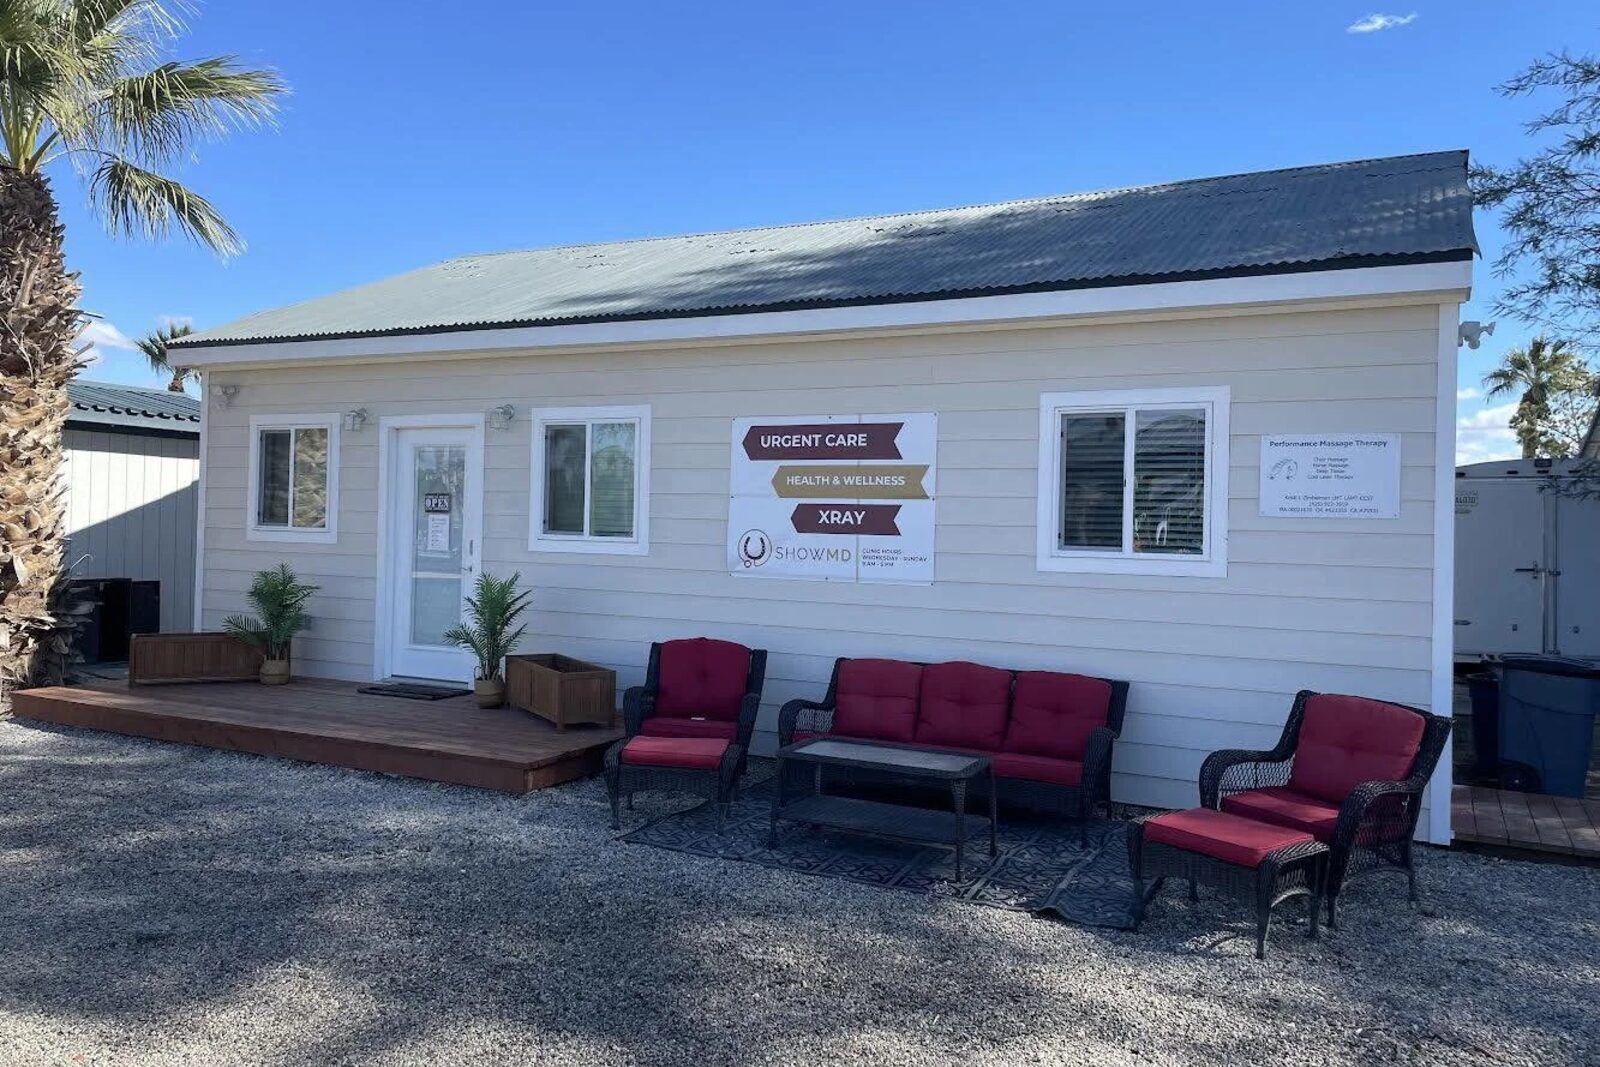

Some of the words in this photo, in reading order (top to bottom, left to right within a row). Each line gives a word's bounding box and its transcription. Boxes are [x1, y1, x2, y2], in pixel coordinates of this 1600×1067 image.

[760, 433, 822, 448] URGENT
[825, 433, 868, 447] CARE
[1269, 440, 1318, 448] Performance
[1319, 440, 1354, 448] Massage
[1355, 439, 1388, 448] Therapy
[786, 475, 830, 486] HEALTH
[832, 475, 840, 485] &
[844, 475, 906, 486] WELLNESS
[425, 498, 449, 508] OPEN
[818, 510, 866, 525] XRAY
[775, 545, 852, 563] SHOWMD
